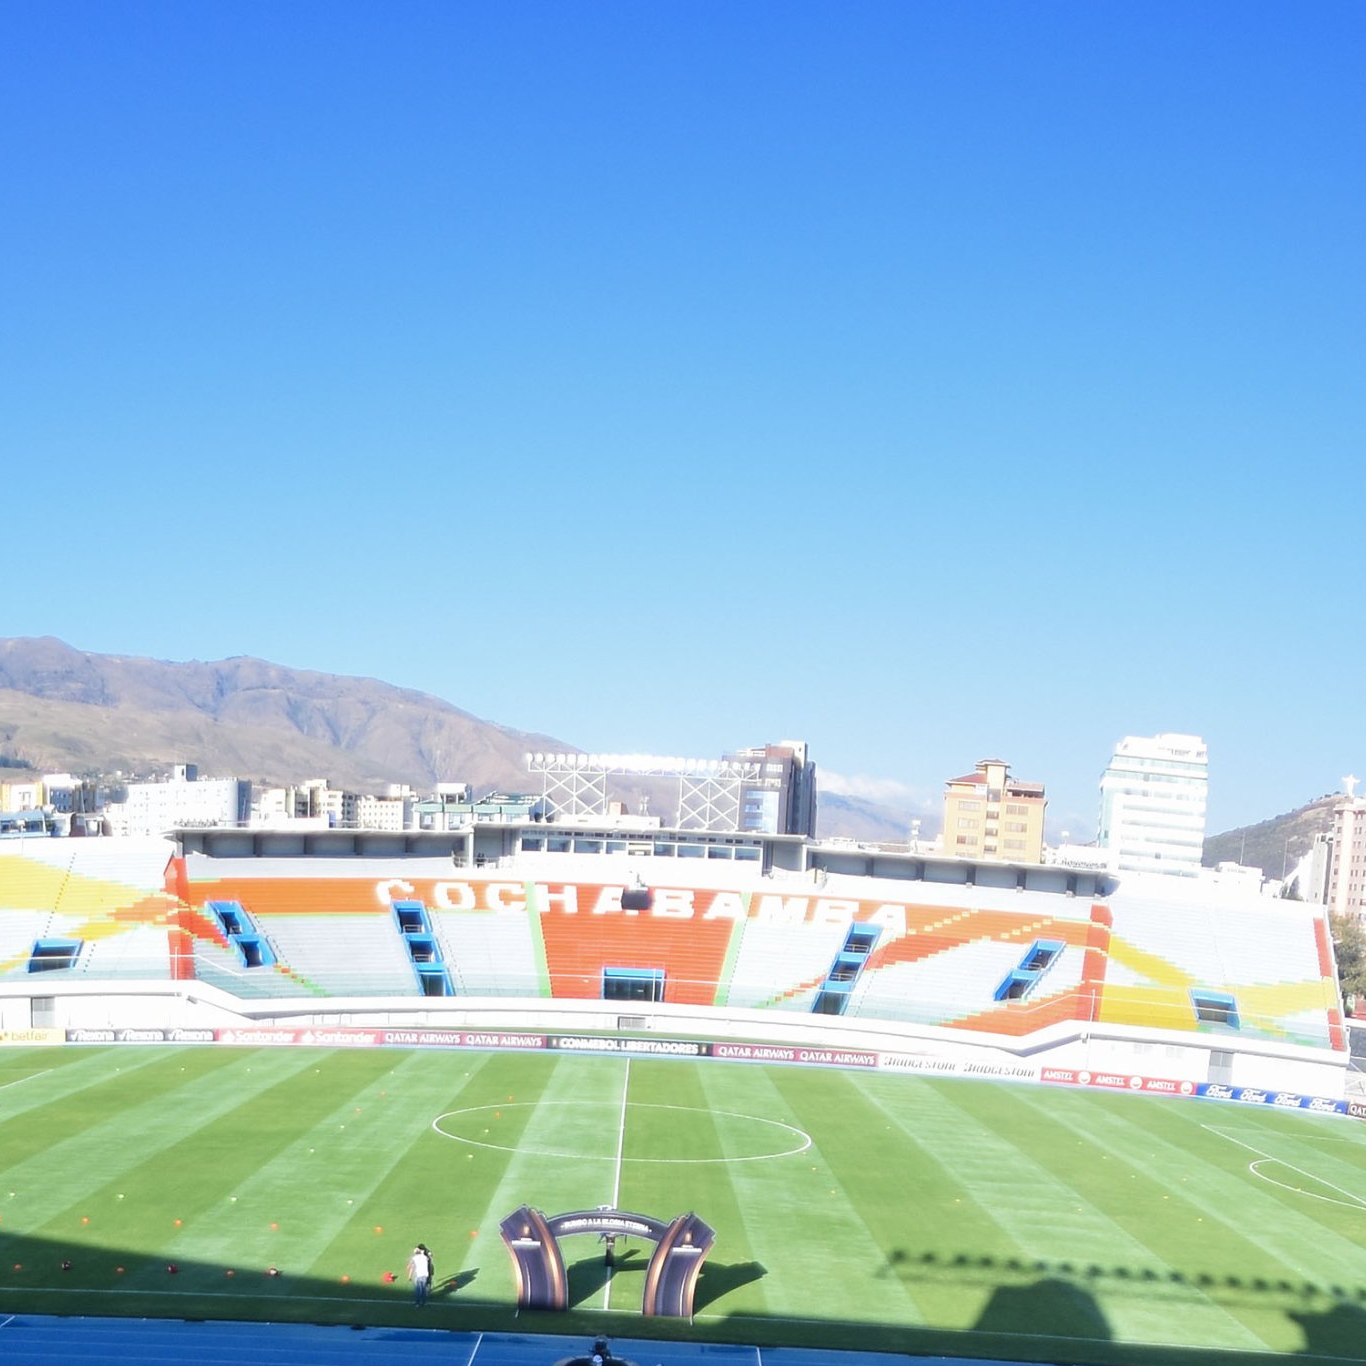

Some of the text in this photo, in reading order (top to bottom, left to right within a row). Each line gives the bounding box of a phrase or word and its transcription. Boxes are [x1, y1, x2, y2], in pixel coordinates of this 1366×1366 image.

[11, 1030, 49, 1042] betfair
[235, 1030, 295, 1043] Santander
[316, 1031, 377, 1044] Santander
[386, 1033, 462, 1045] QATAR AIRWAYS
[467, 1034, 542, 1047] QATAR AIRWAYS
[559, 1038, 699, 1054] CONMEBOL LIBERTADORES
[719, 1046, 795, 1059] QATAR AIRWAYS
[800, 1050, 875, 1065] QATAR AIRWAYS
[1044, 1070, 1074, 1081] AMSTEL
[1096, 1075, 1125, 1086] AMSTEL
[1147, 1080, 1176, 1091] AMSTEL
[1206, 1084, 1233, 1100] Ford
[1240, 1088, 1267, 1103] Ford
[1274, 1092, 1302, 1108] Ford
[1308, 1097, 1336, 1112] Ford
